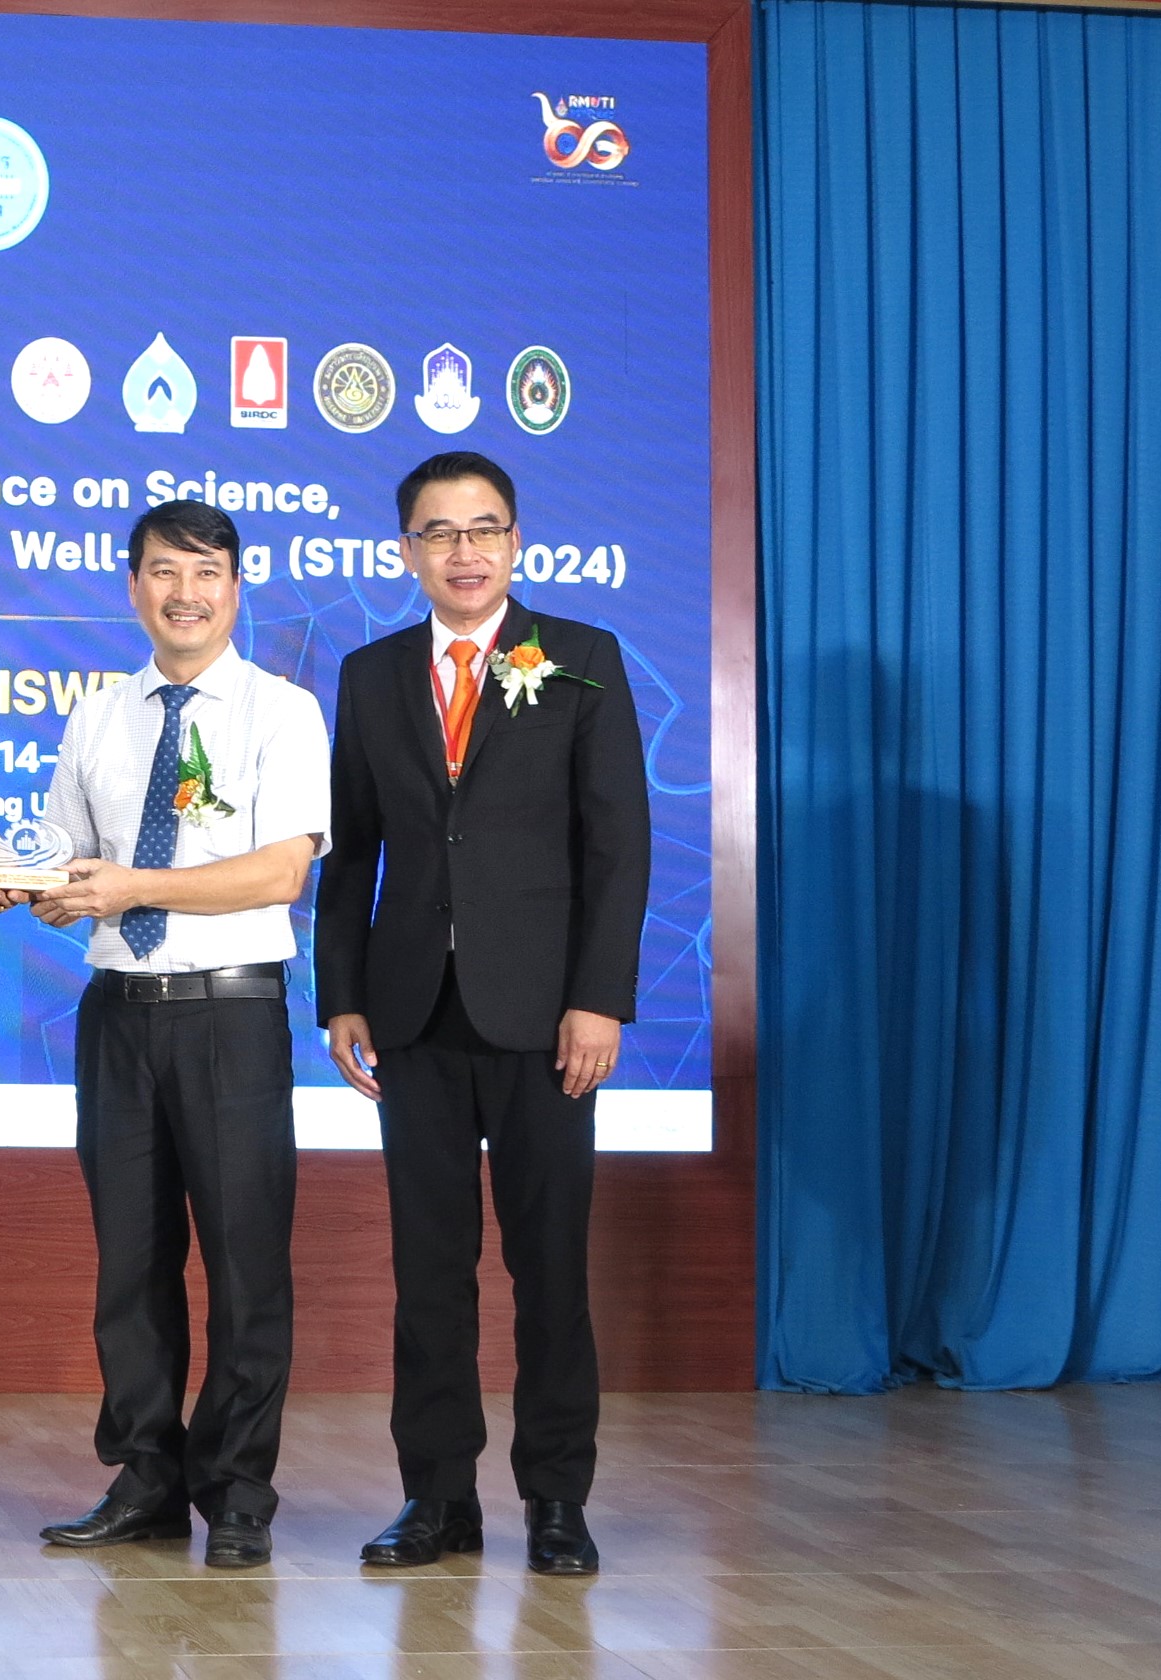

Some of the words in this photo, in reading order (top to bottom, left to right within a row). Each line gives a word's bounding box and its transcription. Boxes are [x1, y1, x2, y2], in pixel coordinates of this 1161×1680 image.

[568, 94, 615, 109] RMUTI
[73, 477, 130, 509] on
[146, 470, 341, 520] Science,
